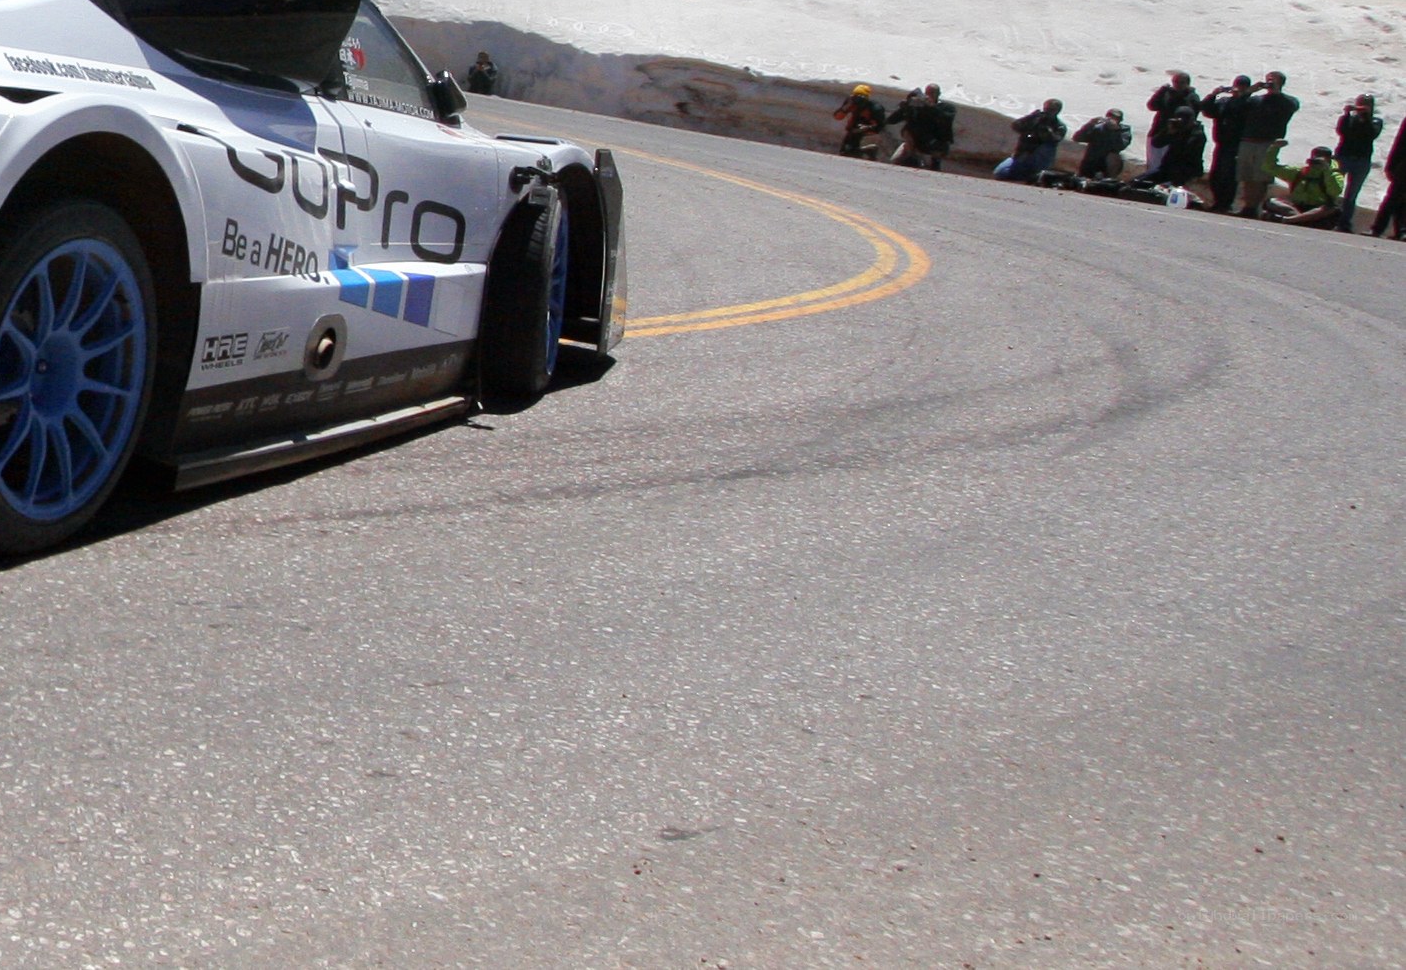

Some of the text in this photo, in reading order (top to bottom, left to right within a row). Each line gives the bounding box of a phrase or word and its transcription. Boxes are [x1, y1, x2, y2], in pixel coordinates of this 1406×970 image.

[222, 217, 330, 285] Be a HERO.
